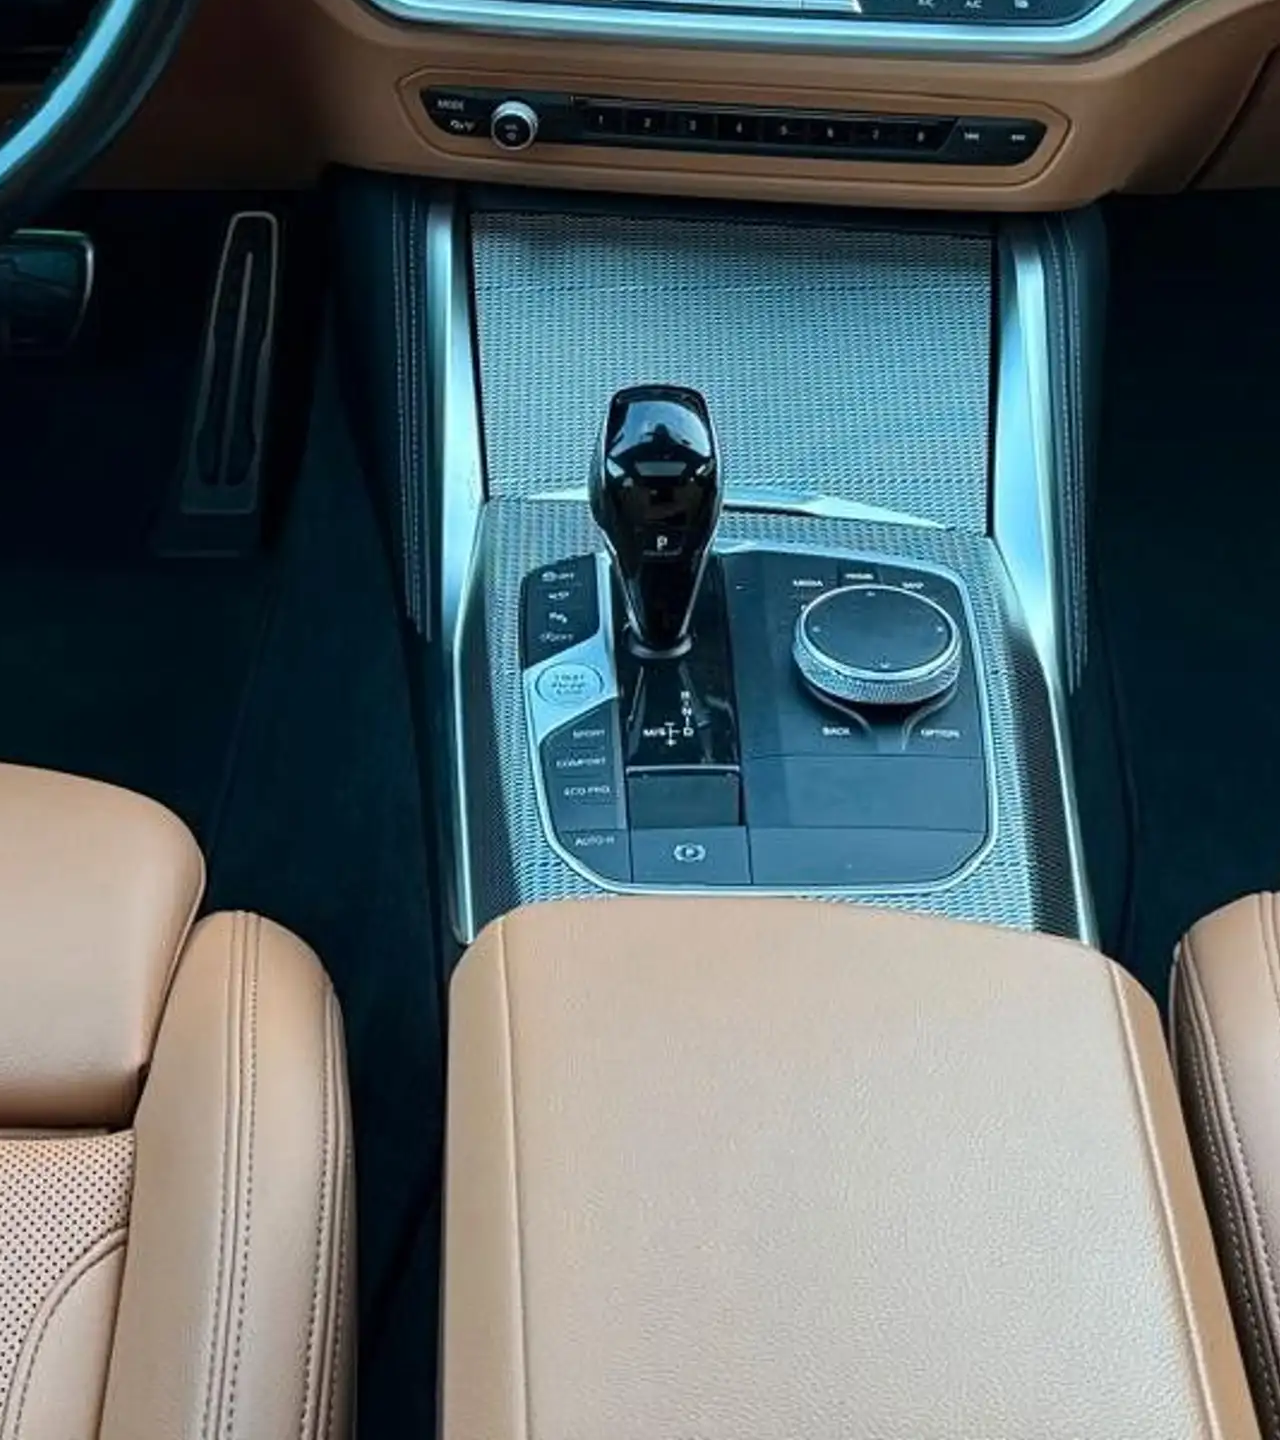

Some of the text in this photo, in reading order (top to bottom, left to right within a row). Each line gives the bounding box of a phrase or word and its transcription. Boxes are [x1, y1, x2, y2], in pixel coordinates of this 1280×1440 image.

[437, 99, 465, 110] MODE
[656, 535, 668, 552] P
[793, 579, 823, 587] MEDIA
[681, 707, 692, 716] N
[572, 728, 606, 740] SPORT
[683, 727, 694, 737] D
[822, 727, 851, 736] BACK
[920, 728, 960, 738] OPTION
[556, 757, 606, 768] COMFORT
